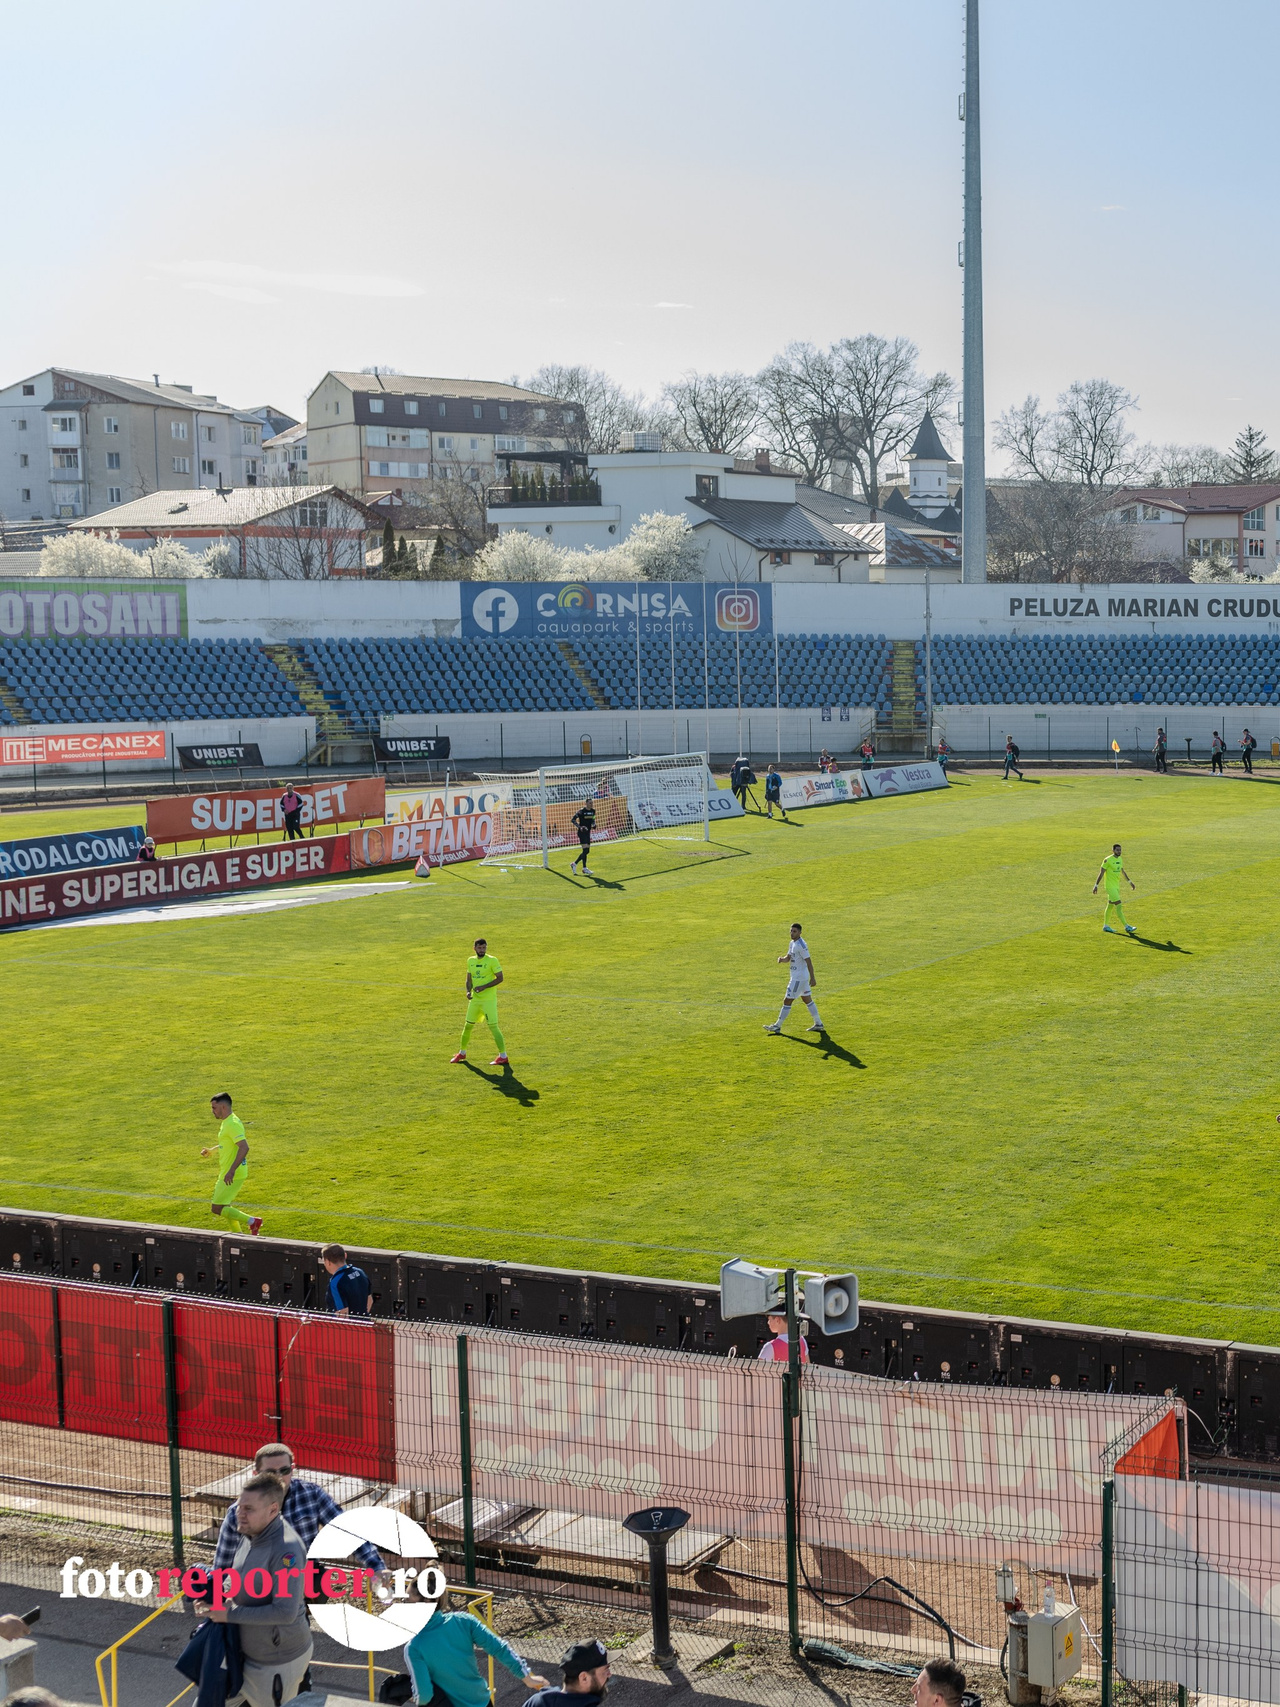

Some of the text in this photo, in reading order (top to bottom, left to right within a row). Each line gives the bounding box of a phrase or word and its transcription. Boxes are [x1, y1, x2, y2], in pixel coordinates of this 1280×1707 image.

[1009, 598, 1100, 617] PELUZA
[1107, 598, 1199, 617] MARIAN
[537, 620, 694, 635] aquapark & sports
[48, 734, 161, 751] MECANEX
[386, 739, 436, 752] UNIBET
[192, 747, 245, 760] UNIBET
[901, 768, 932, 782] Vestra
[814, 777, 847, 791] Smart Eco
[783, 791, 803, 799] ELSACO
[838, 788, 849, 796] Plus
[400, 792, 503, 822] MADO
[391, 815, 492, 861] BETANO
[62, 861, 221, 908] SUPERLIGA
[226, 857, 241, 883] E
[246, 845, 325, 880] SUPER
